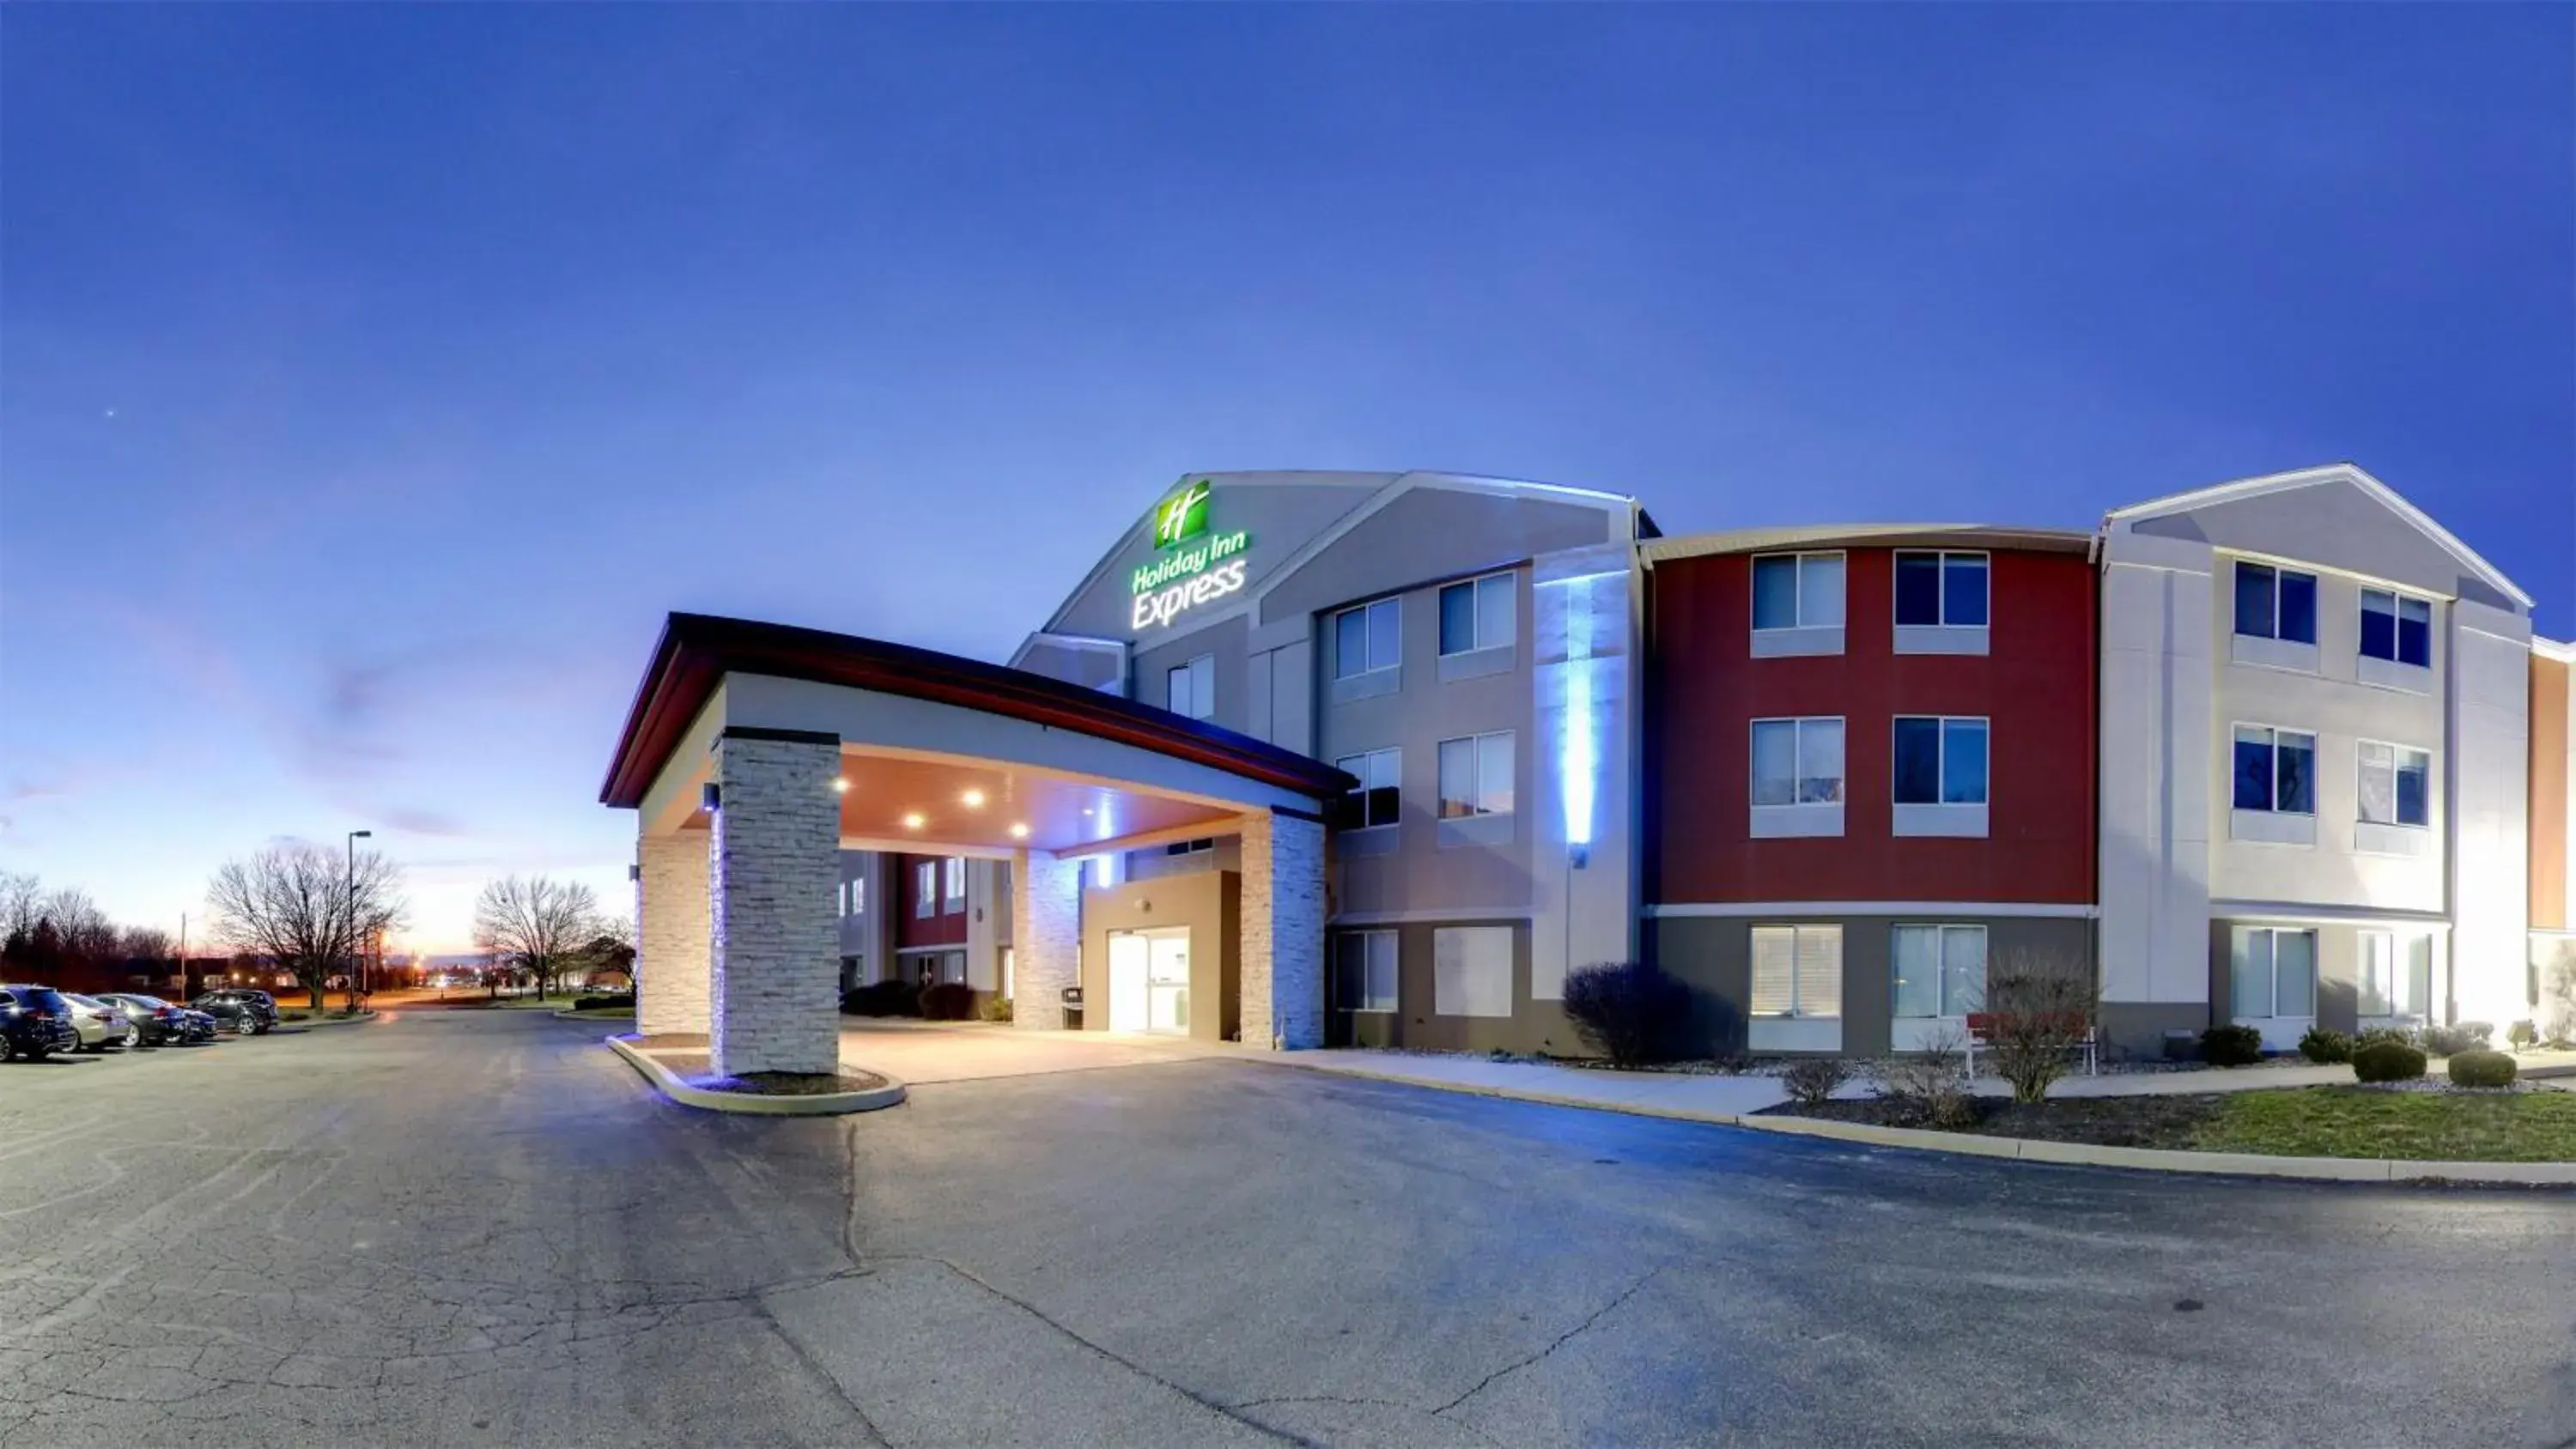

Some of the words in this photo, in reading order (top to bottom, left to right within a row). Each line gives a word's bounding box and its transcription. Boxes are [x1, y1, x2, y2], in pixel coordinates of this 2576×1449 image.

[1132, 547, 1208, 595] Holiday
[1211, 532, 1246, 561] Inn
[1132, 560, 1246, 629] Express
